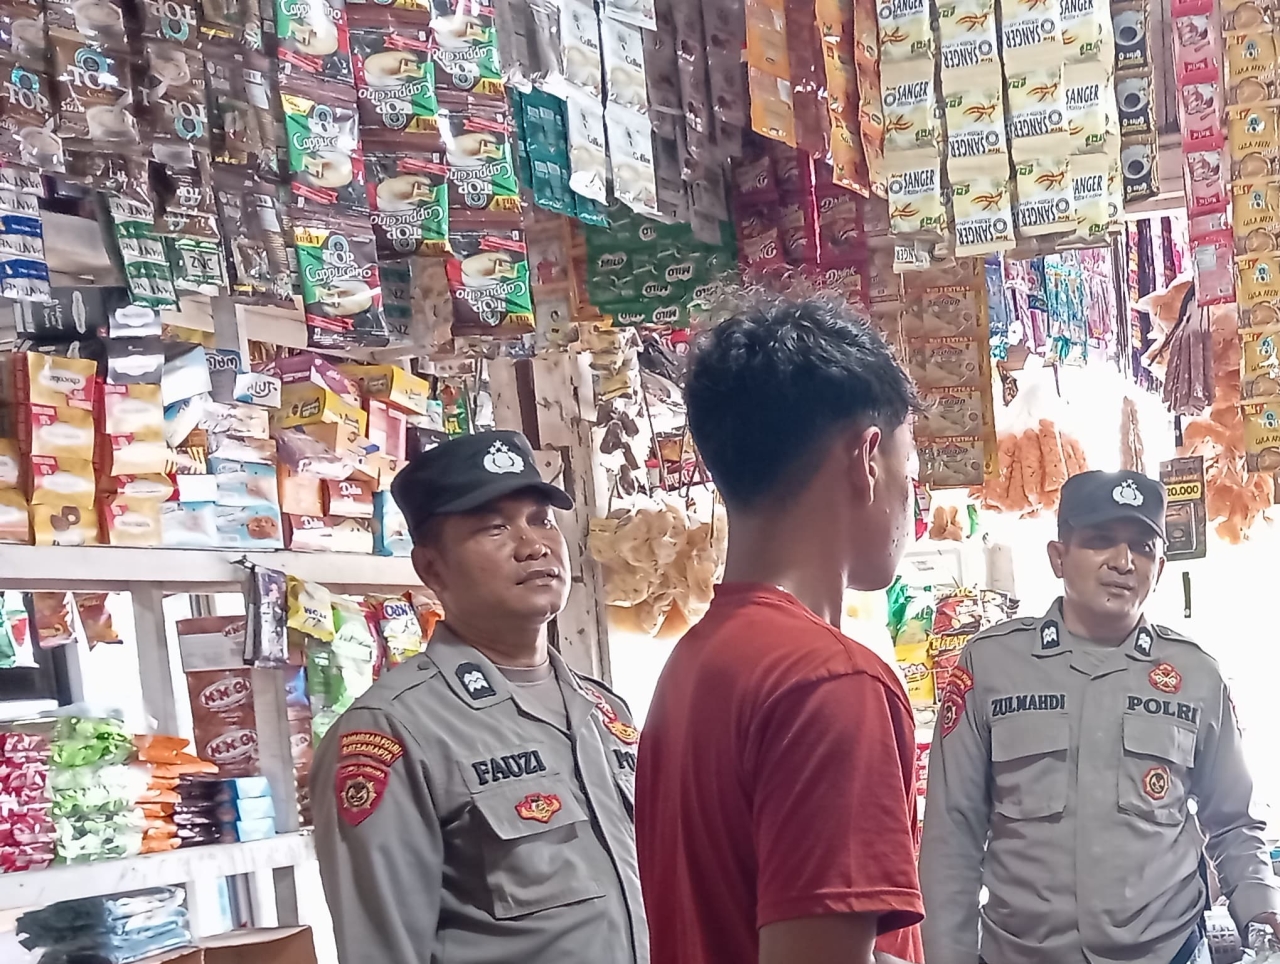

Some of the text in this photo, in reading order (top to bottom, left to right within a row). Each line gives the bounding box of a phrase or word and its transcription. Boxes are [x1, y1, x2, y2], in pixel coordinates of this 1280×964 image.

[1004, 24, 1041, 48] SANGER
[942, 46, 979, 69] SANGER
[897, 81, 929, 101] SANGER
[1065, 84, 1099, 105] SANGER
[949, 136, 986, 158] SANGER
[903, 169, 935, 190] SANGER
[1072, 174, 1103, 196] ANGER
[370, 205, 445, 230] Cappuccino
[1020, 203, 1056, 227] SANGER
[957, 223, 994, 245] SANGER
[305, 263, 372, 285] Cappuccino
[991, 694, 1067, 718] ZULMAHDI
[1127, 695, 1198, 724] POLRI
[471, 749, 547, 786] FAUZI
